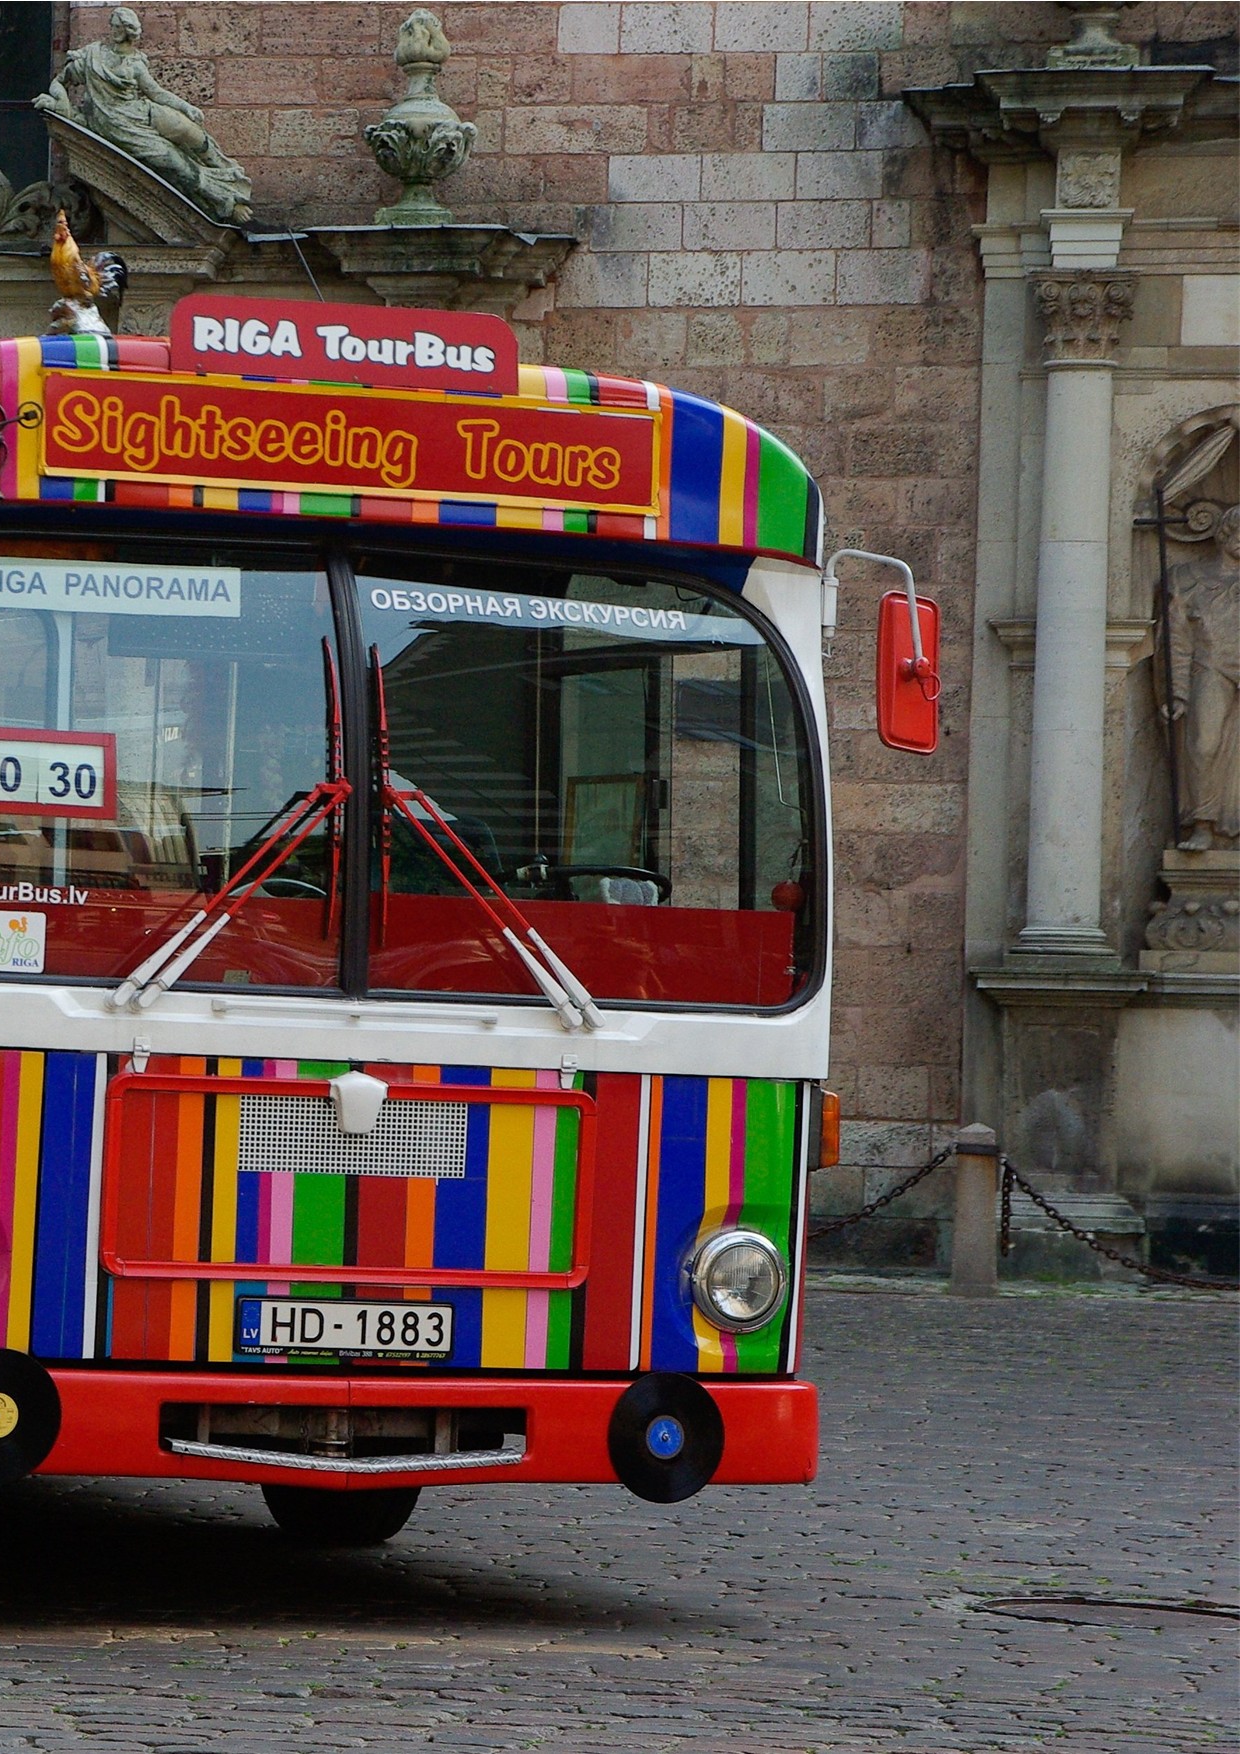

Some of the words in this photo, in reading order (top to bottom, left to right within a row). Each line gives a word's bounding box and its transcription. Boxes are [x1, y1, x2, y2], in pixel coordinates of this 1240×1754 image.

[192, 315, 304, 359] RIGA
[317, 323, 496, 374] TourBus
[51, 389, 420, 489] Sightseeing
[457, 417, 622, 491] Tours
[64, 572, 232, 604] PANORAMA
[369, 587, 523, 619] ОБЗОРНАЯ
[529, 597, 687, 632] ЭКСКУРСИЯ
[48, 762, 97, 799] 30
[12, 957, 40, 967] RIGA
[242, 1327, 259, 1339] LV
